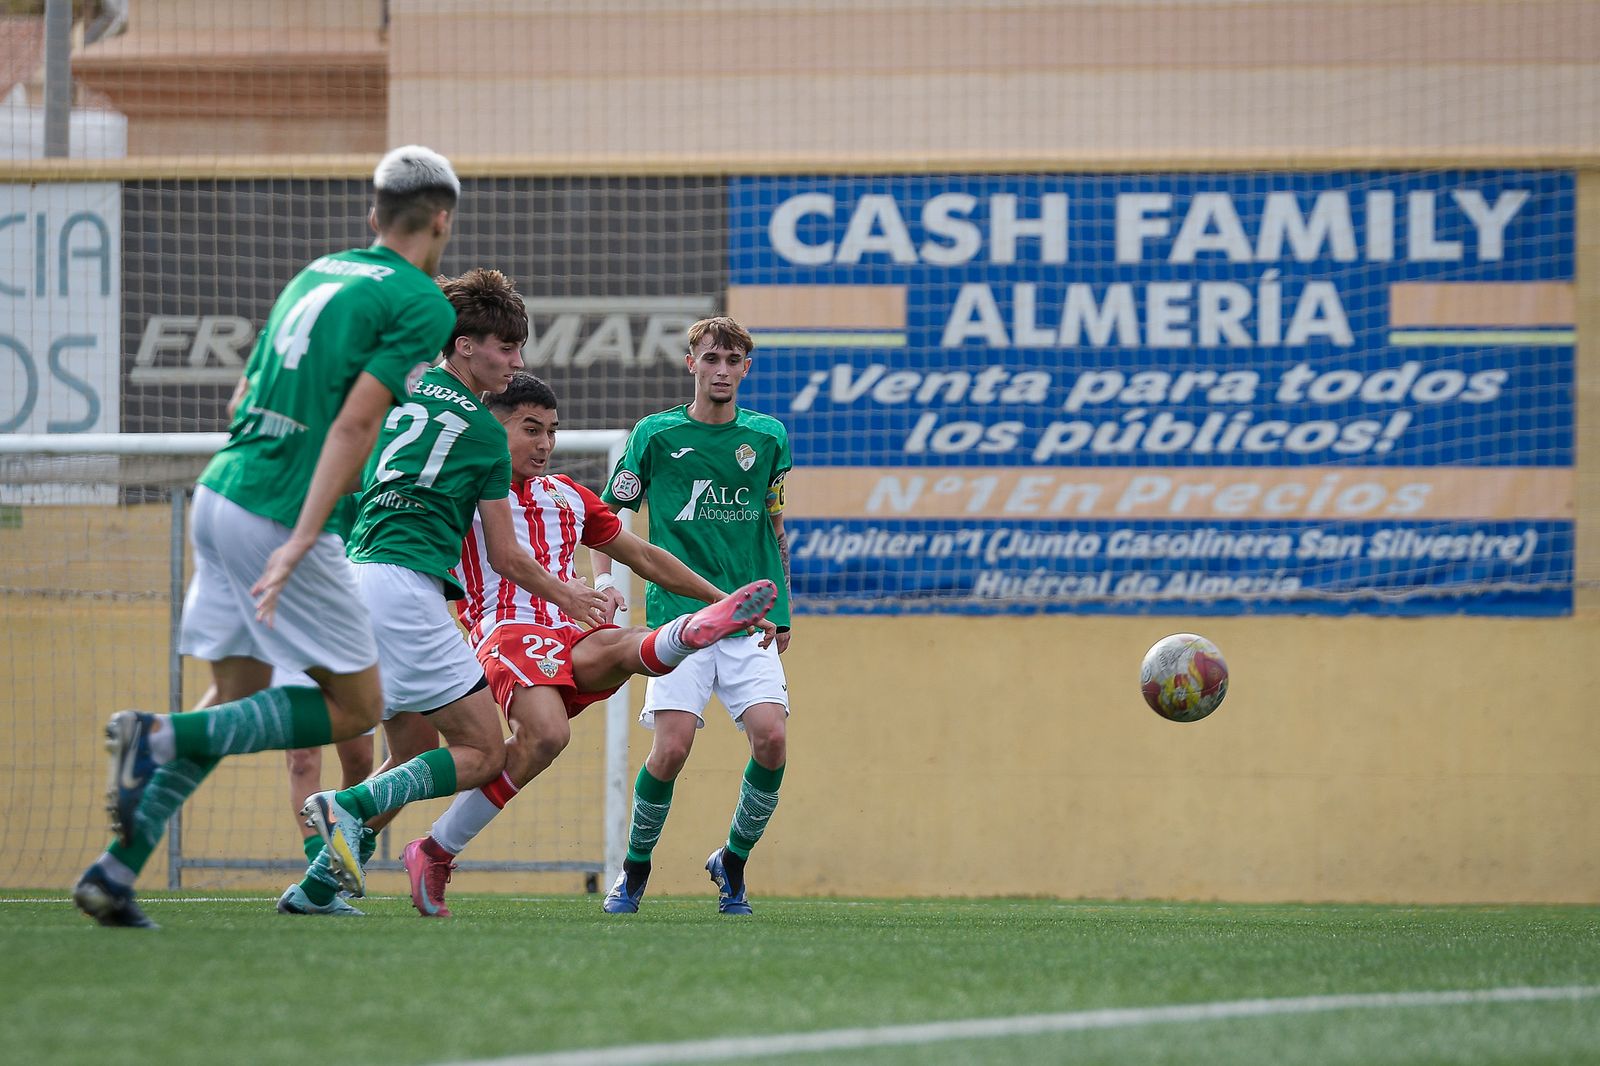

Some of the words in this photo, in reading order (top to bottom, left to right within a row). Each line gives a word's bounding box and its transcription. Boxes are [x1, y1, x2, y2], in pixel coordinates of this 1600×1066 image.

[768, 191, 1069, 266] CASH
[1115, 189, 1531, 265] FAMILY
[273, 281, 345, 371] 4
[942, 269, 1355, 348] ALMERÍA
[415, 380, 478, 412] LUCHO
[790, 363, 1052, 412] ¡Venta
[1064, 369, 1260, 413] para
[1276, 361, 1508, 402] todos
[376, 402, 471, 488] 21
[904, 412, 1025, 453] los
[1032, 408, 1413, 463] públicos!
[701, 486, 750, 506] ALC
[1003, 475, 1104, 514] En
[1114, 473, 1433, 514] Precios
[698, 507, 760, 524] Abogados
[796, 524, 927, 565] Júpiter
[984, 527, 1101, 565] (Junto
[1106, 528, 1292, 560] Gasolinera
[1295, 530, 1362, 560] San
[1367, 529, 1538, 566] Silvestre)
[973, 566, 1112, 599] Huércal
[1113, 571, 1161, 599] de
[1163, 569, 1300, 600] Almería
[522, 634, 566, 665] 22
